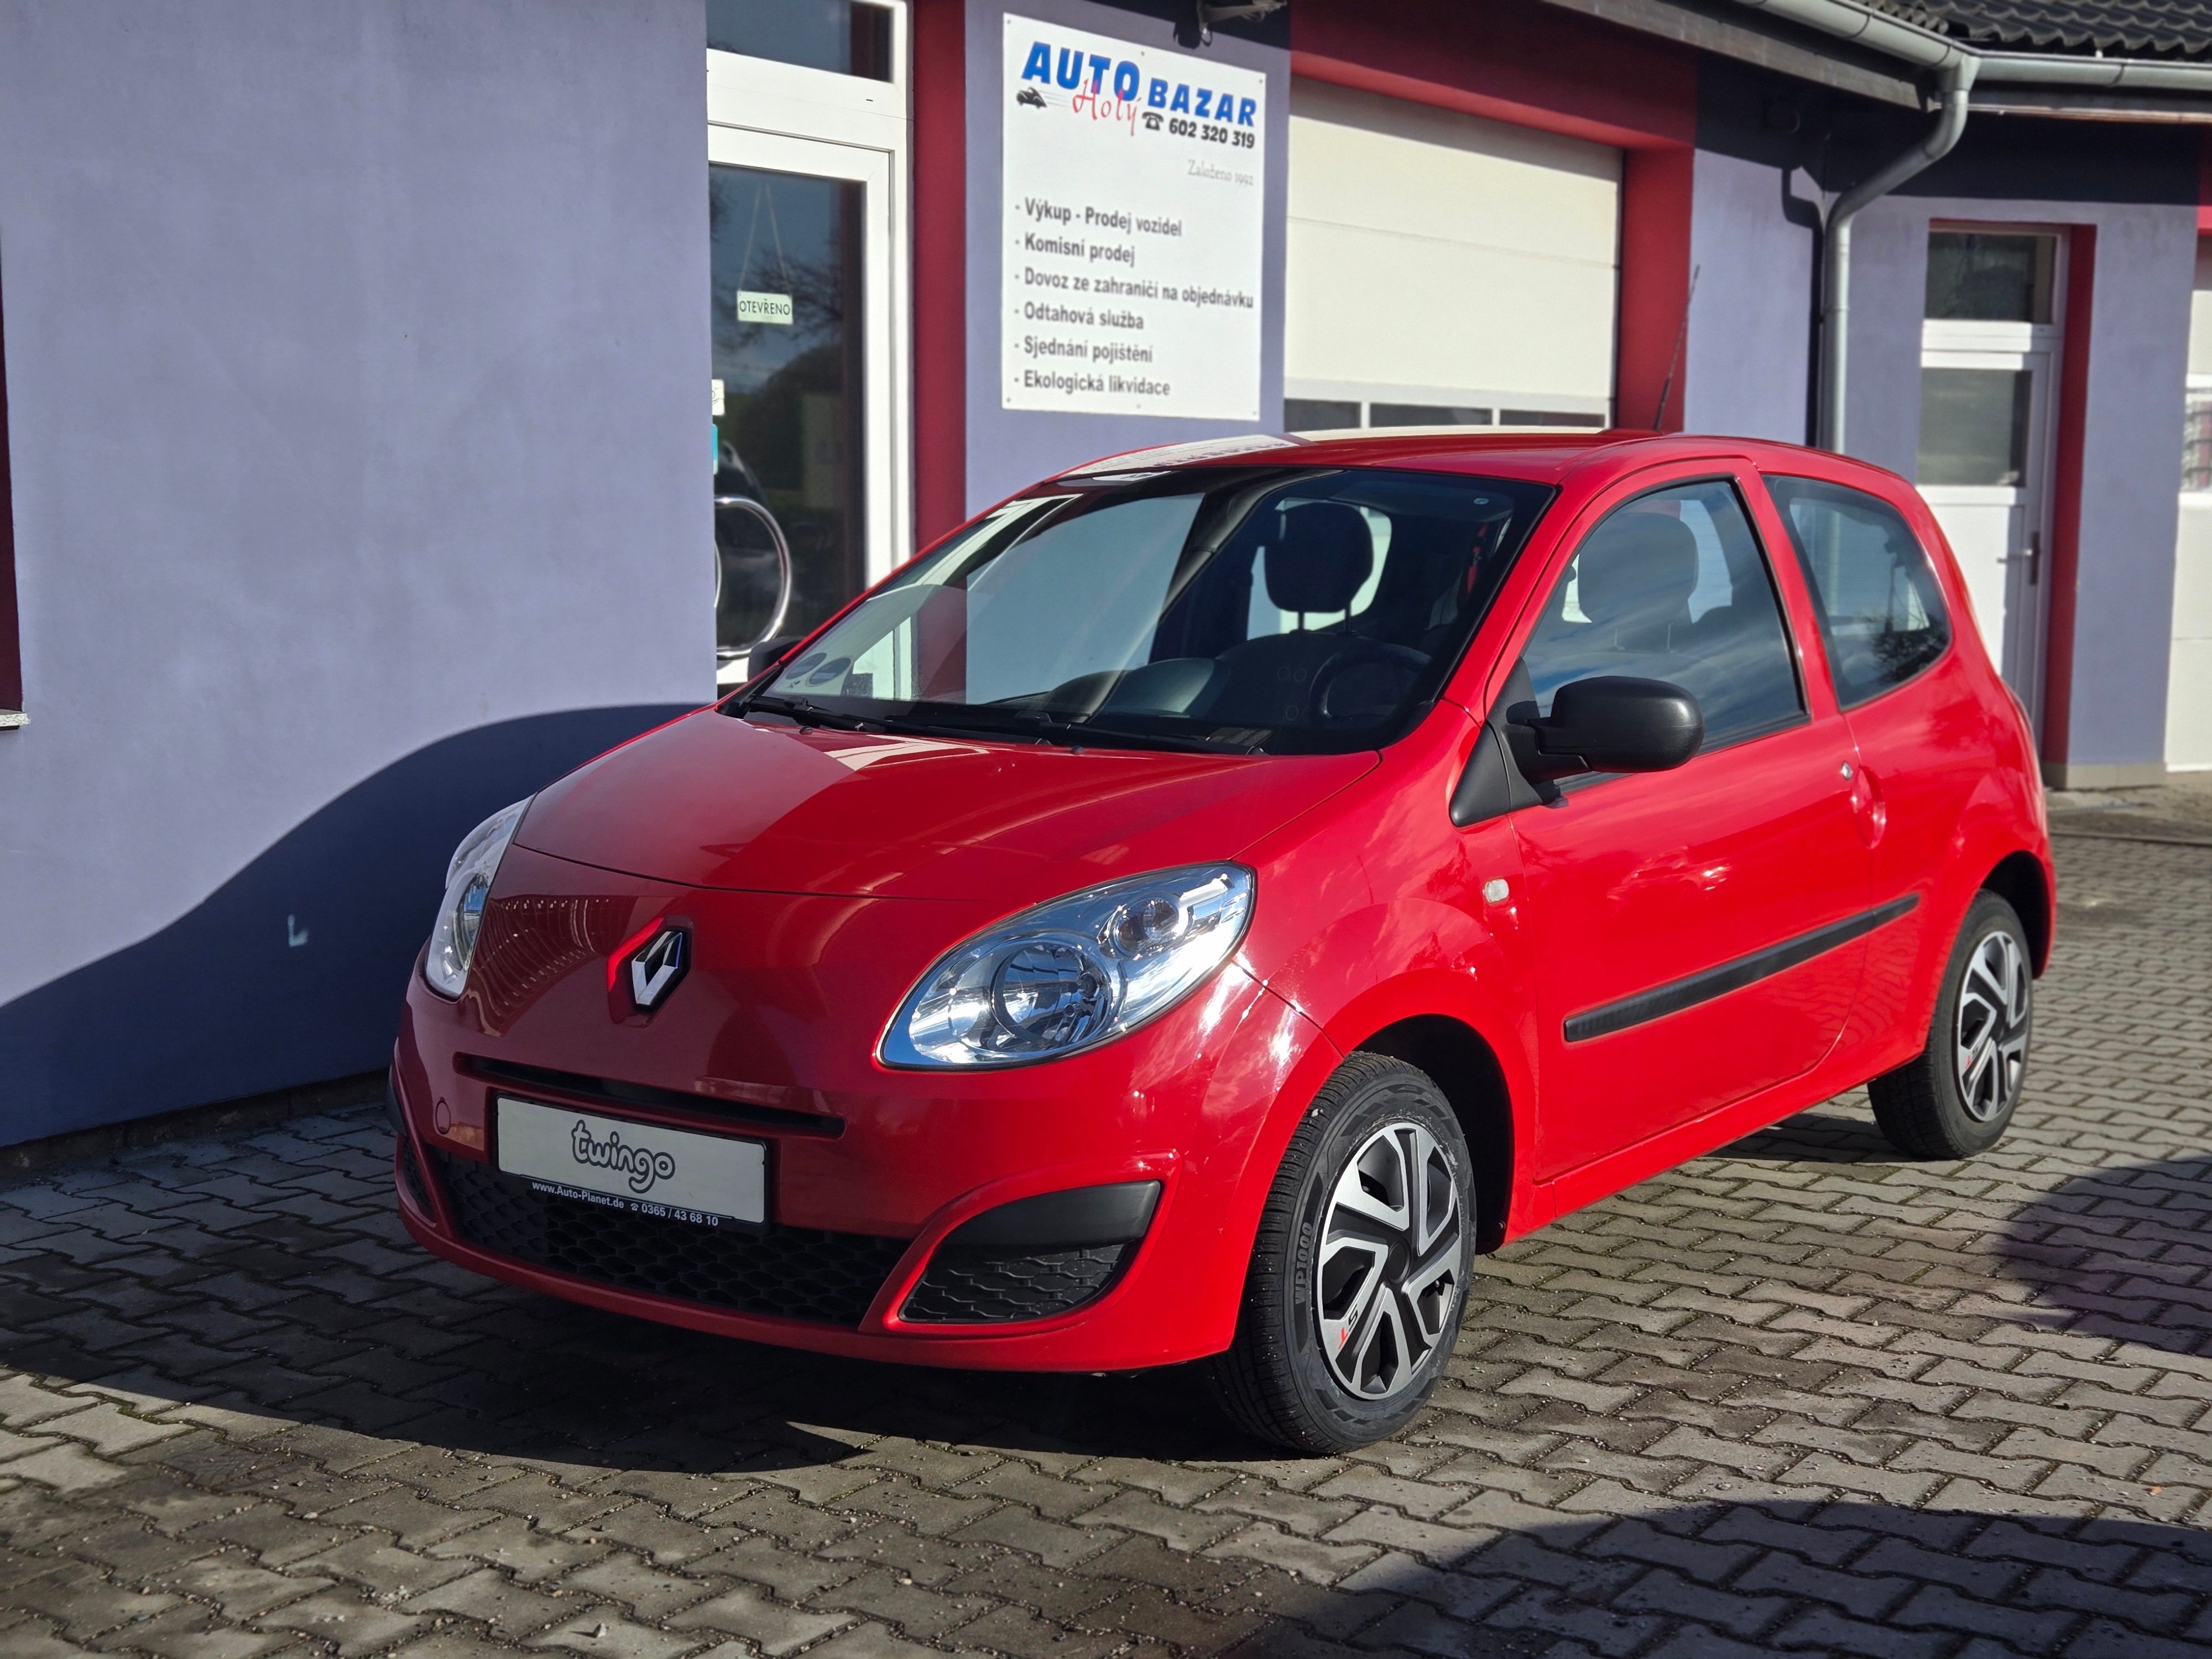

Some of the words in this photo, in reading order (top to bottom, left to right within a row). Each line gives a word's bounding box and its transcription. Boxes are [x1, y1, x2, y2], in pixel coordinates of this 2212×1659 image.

[1021, 41, 1140, 102] AUTO
[1147, 77, 1257, 127] BAZAR
[1072, 78, 1142, 137] Holý
[1168, 117, 1197, 138] 602
[1201, 124, 1228, 144] 320
[1231, 130, 1255, 149] 319
[1188, 158, 1233, 182] Založeno
[1234, 172, 1254, 187] 1992
[1025, 197, 1072, 226] Výkup
[1084, 206, 1131, 234] Prodej
[1135, 216, 1182, 237] vozidel
[1025, 232, 1085, 257] Komisní
[1089, 244, 1135, 268] prodej
[739, 298, 791, 316] OTEVŘENO
[1025, 267, 1069, 289] Dovoz
[1073, 276, 1089, 291] ze
[1094, 276, 1158, 299] zahraničí
[1162, 286, 1178, 300] na
[1182, 284, 1254, 309] objednávku
[1024, 301, 1094, 325] Odtahová
[1099, 309, 1144, 330] služba
[1024, 335, 1088, 359] Sjednání
[1092, 342, 1153, 364] pojištění
[1024, 369, 1104, 394] Ekologická
[1108, 375, 1171, 395] likvidace
[571, 1119, 676, 1194] twingo
[532, 1181, 624, 1209] www.Auto-Planet.de
[641, 1203, 666, 1217] 0365
[674, 1210, 687, 1221] 43
[689, 1213, 703, 1224] 68
[706, 1215, 719, 1227] 10
[1295, 1222, 1313, 1305] WP1000
